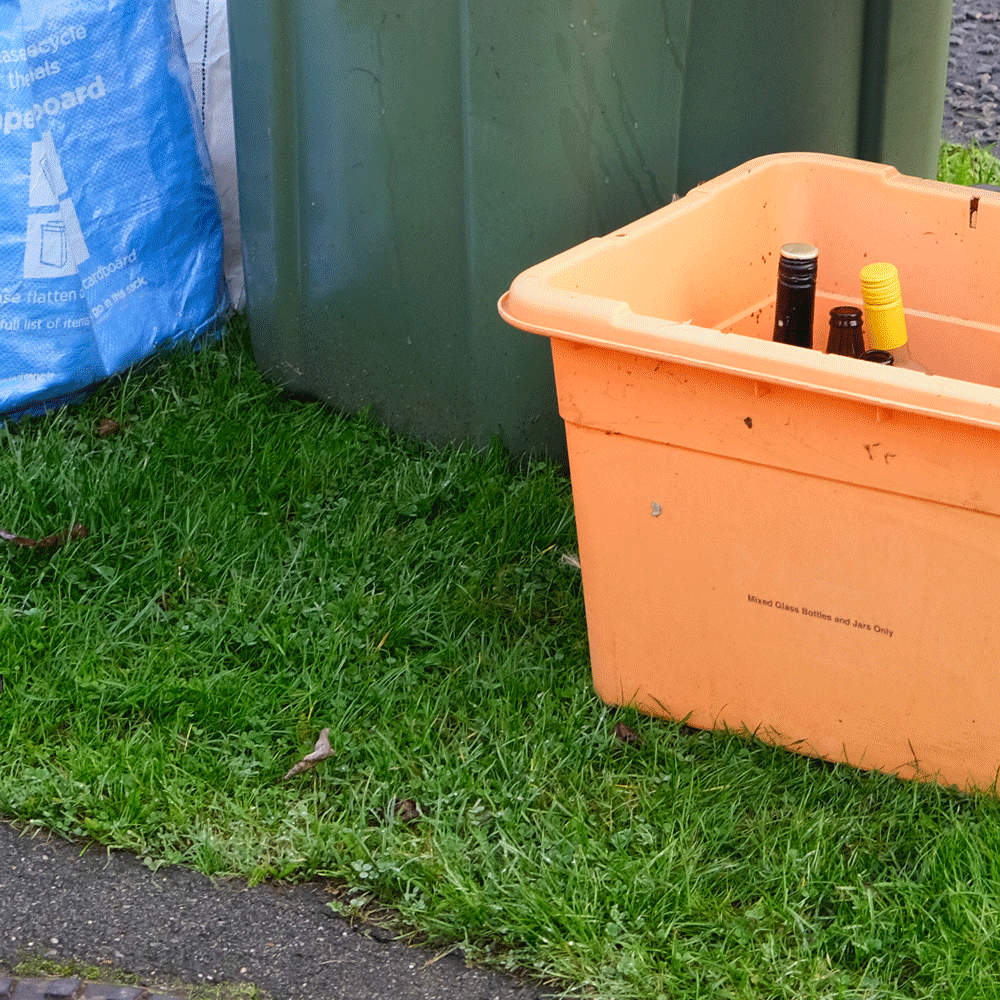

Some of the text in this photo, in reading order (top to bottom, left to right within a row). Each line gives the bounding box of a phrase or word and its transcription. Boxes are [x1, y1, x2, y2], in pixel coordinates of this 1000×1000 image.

[27, 290, 77, 304] flatten
[82, 248, 137, 289] cardboard
[24, 318, 42, 330] list
[46, 317, 61, 329] of
[747, 594, 894, 638] Mixed Glass Bottles and Jars Only
